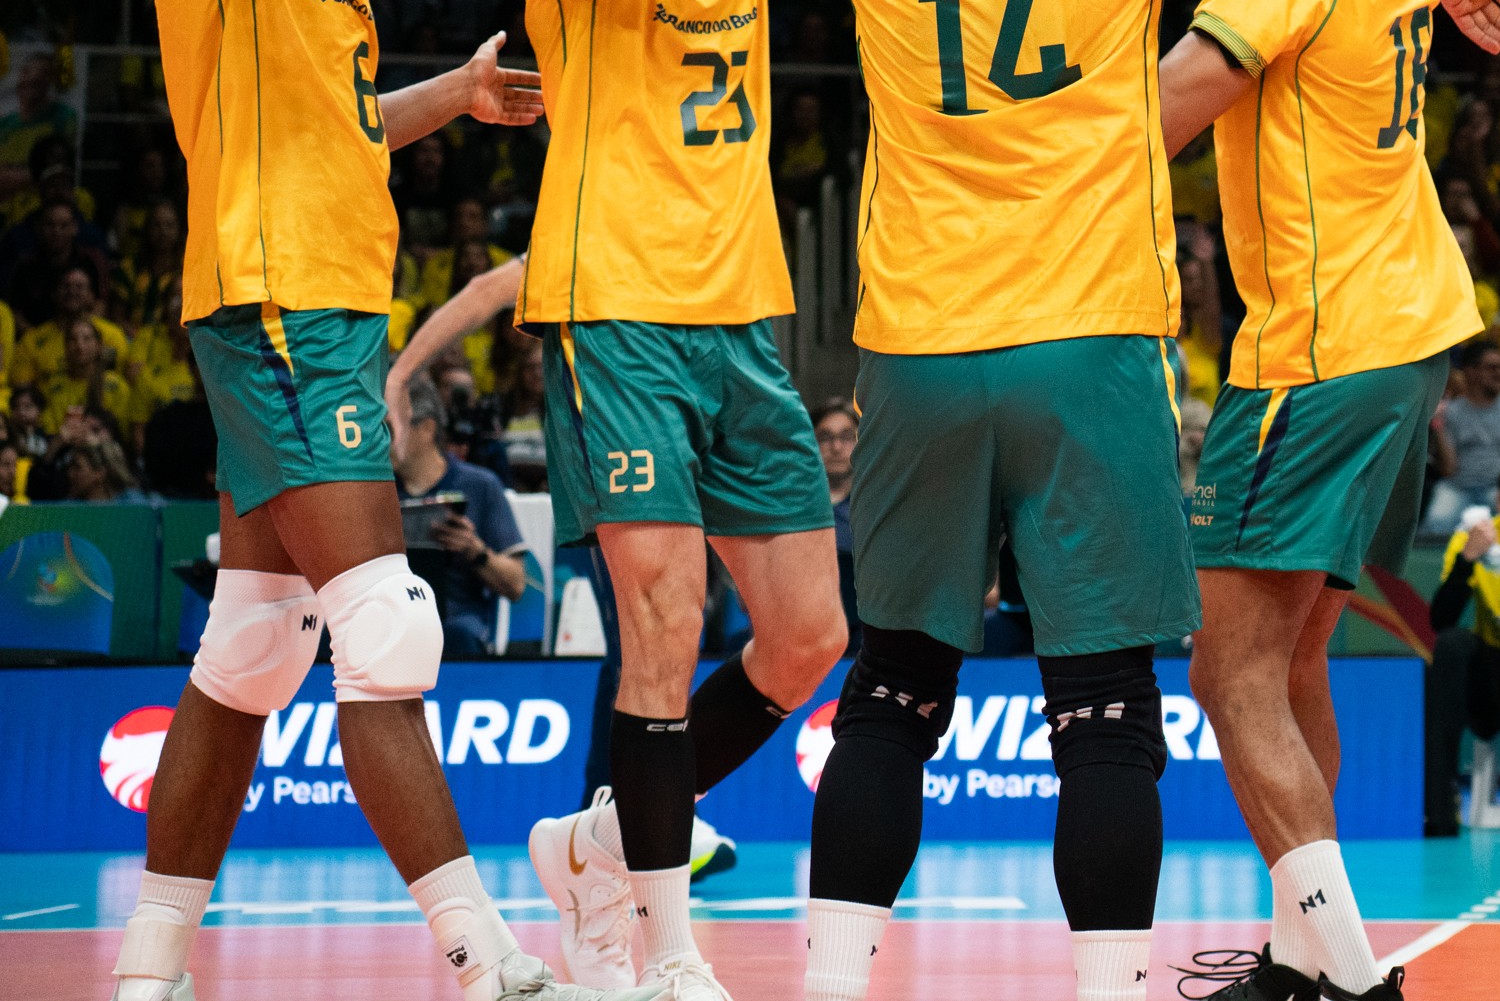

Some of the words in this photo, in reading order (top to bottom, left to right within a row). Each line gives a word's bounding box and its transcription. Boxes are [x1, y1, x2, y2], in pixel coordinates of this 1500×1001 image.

[353, 40, 386, 144] 6
[680, 51, 757, 146] 23
[336, 404, 362, 449] 6
[607, 449, 656, 494] 23
[1193, 482, 1217, 499] nel
[272, 776, 358, 805] Pears
[924, 768, 961, 806] by
[966, 769, 1061, 799] Pears
[1298, 888, 1327, 915] N1
